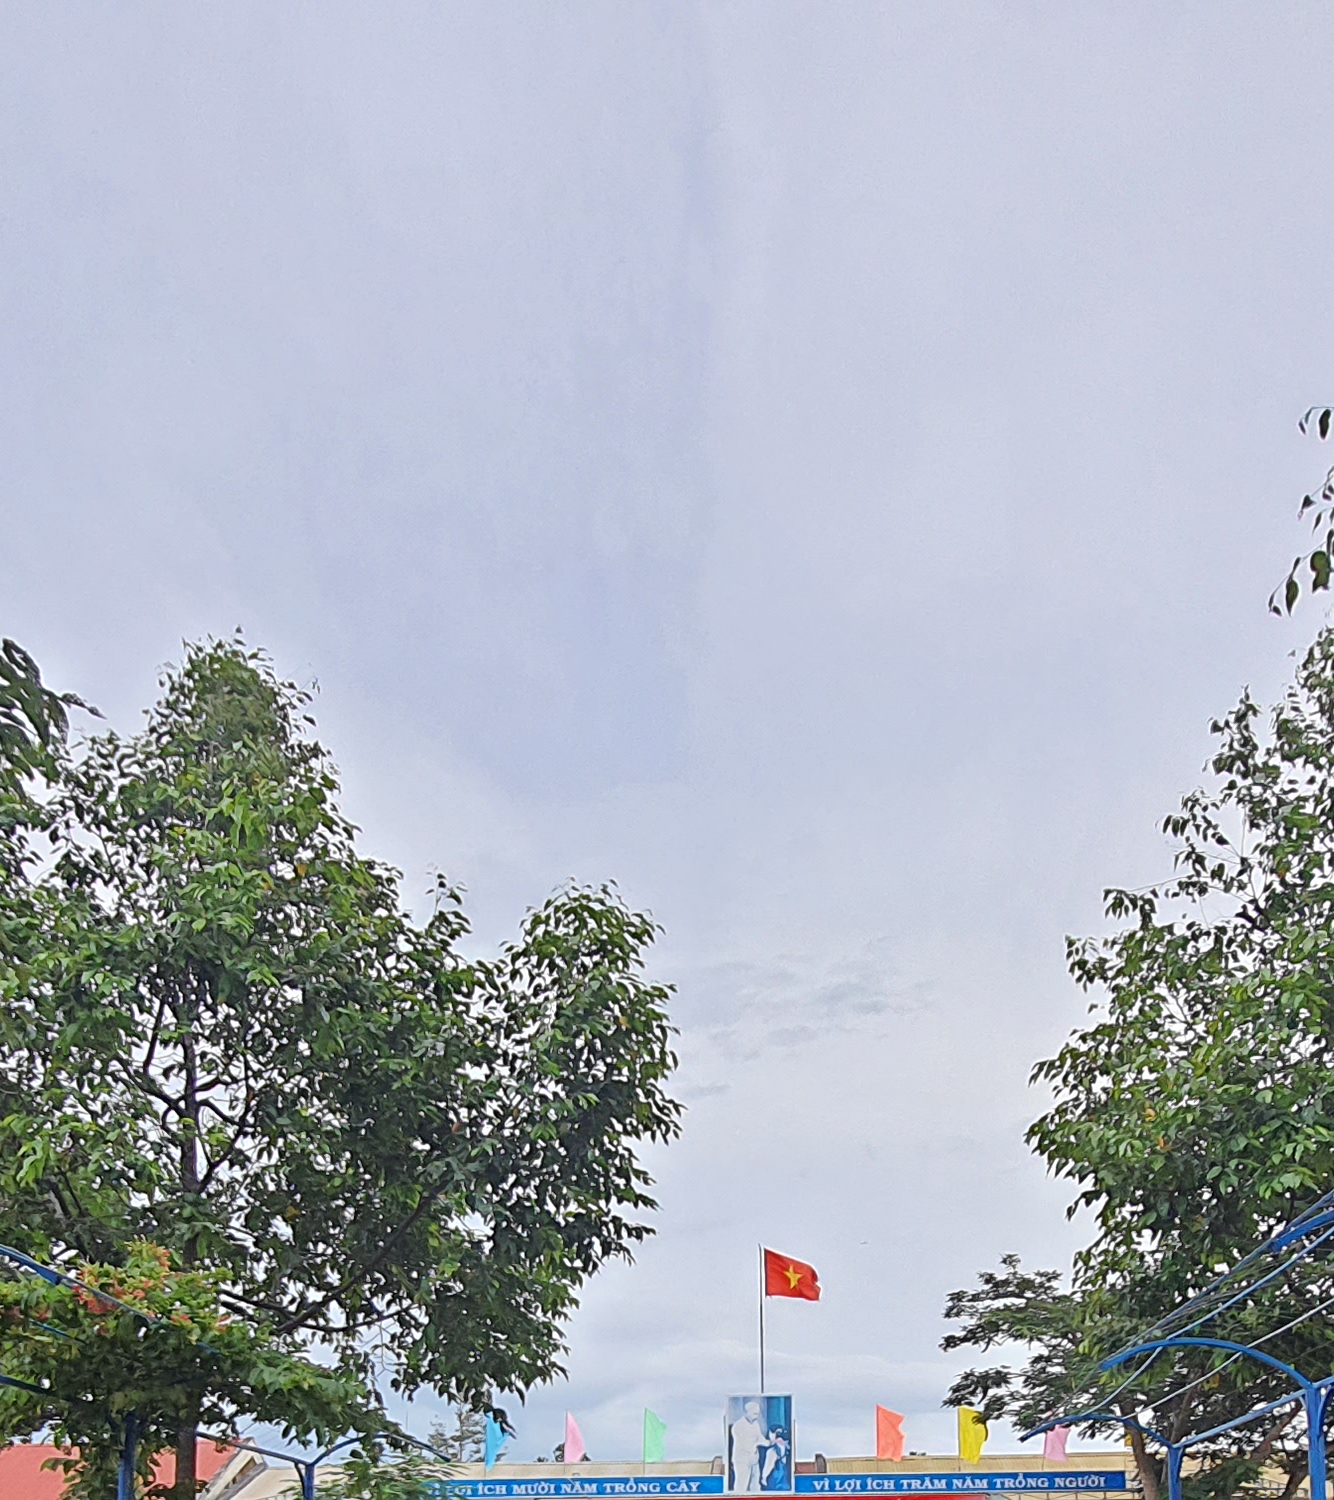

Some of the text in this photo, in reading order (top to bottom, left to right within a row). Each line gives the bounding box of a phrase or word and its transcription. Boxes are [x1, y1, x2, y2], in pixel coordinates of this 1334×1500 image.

[477, 1482, 507, 1495] ÍCH
[512, 1482, 555, 1495] MƯỜI
[560, 1481, 597, 1494] NĂM
[666, 1480, 700, 1492] CÂY
[813, 1479, 830, 1491] VÌ
[835, 1481, 861, 1493] LỢI
[866, 1478, 895, 1491] ÍCH
[900, 1477, 946, 1490] TRĂM
[952, 1476, 988, 1490] NĂM
[1054, 1475, 1106, 1489] NGƯỜI
